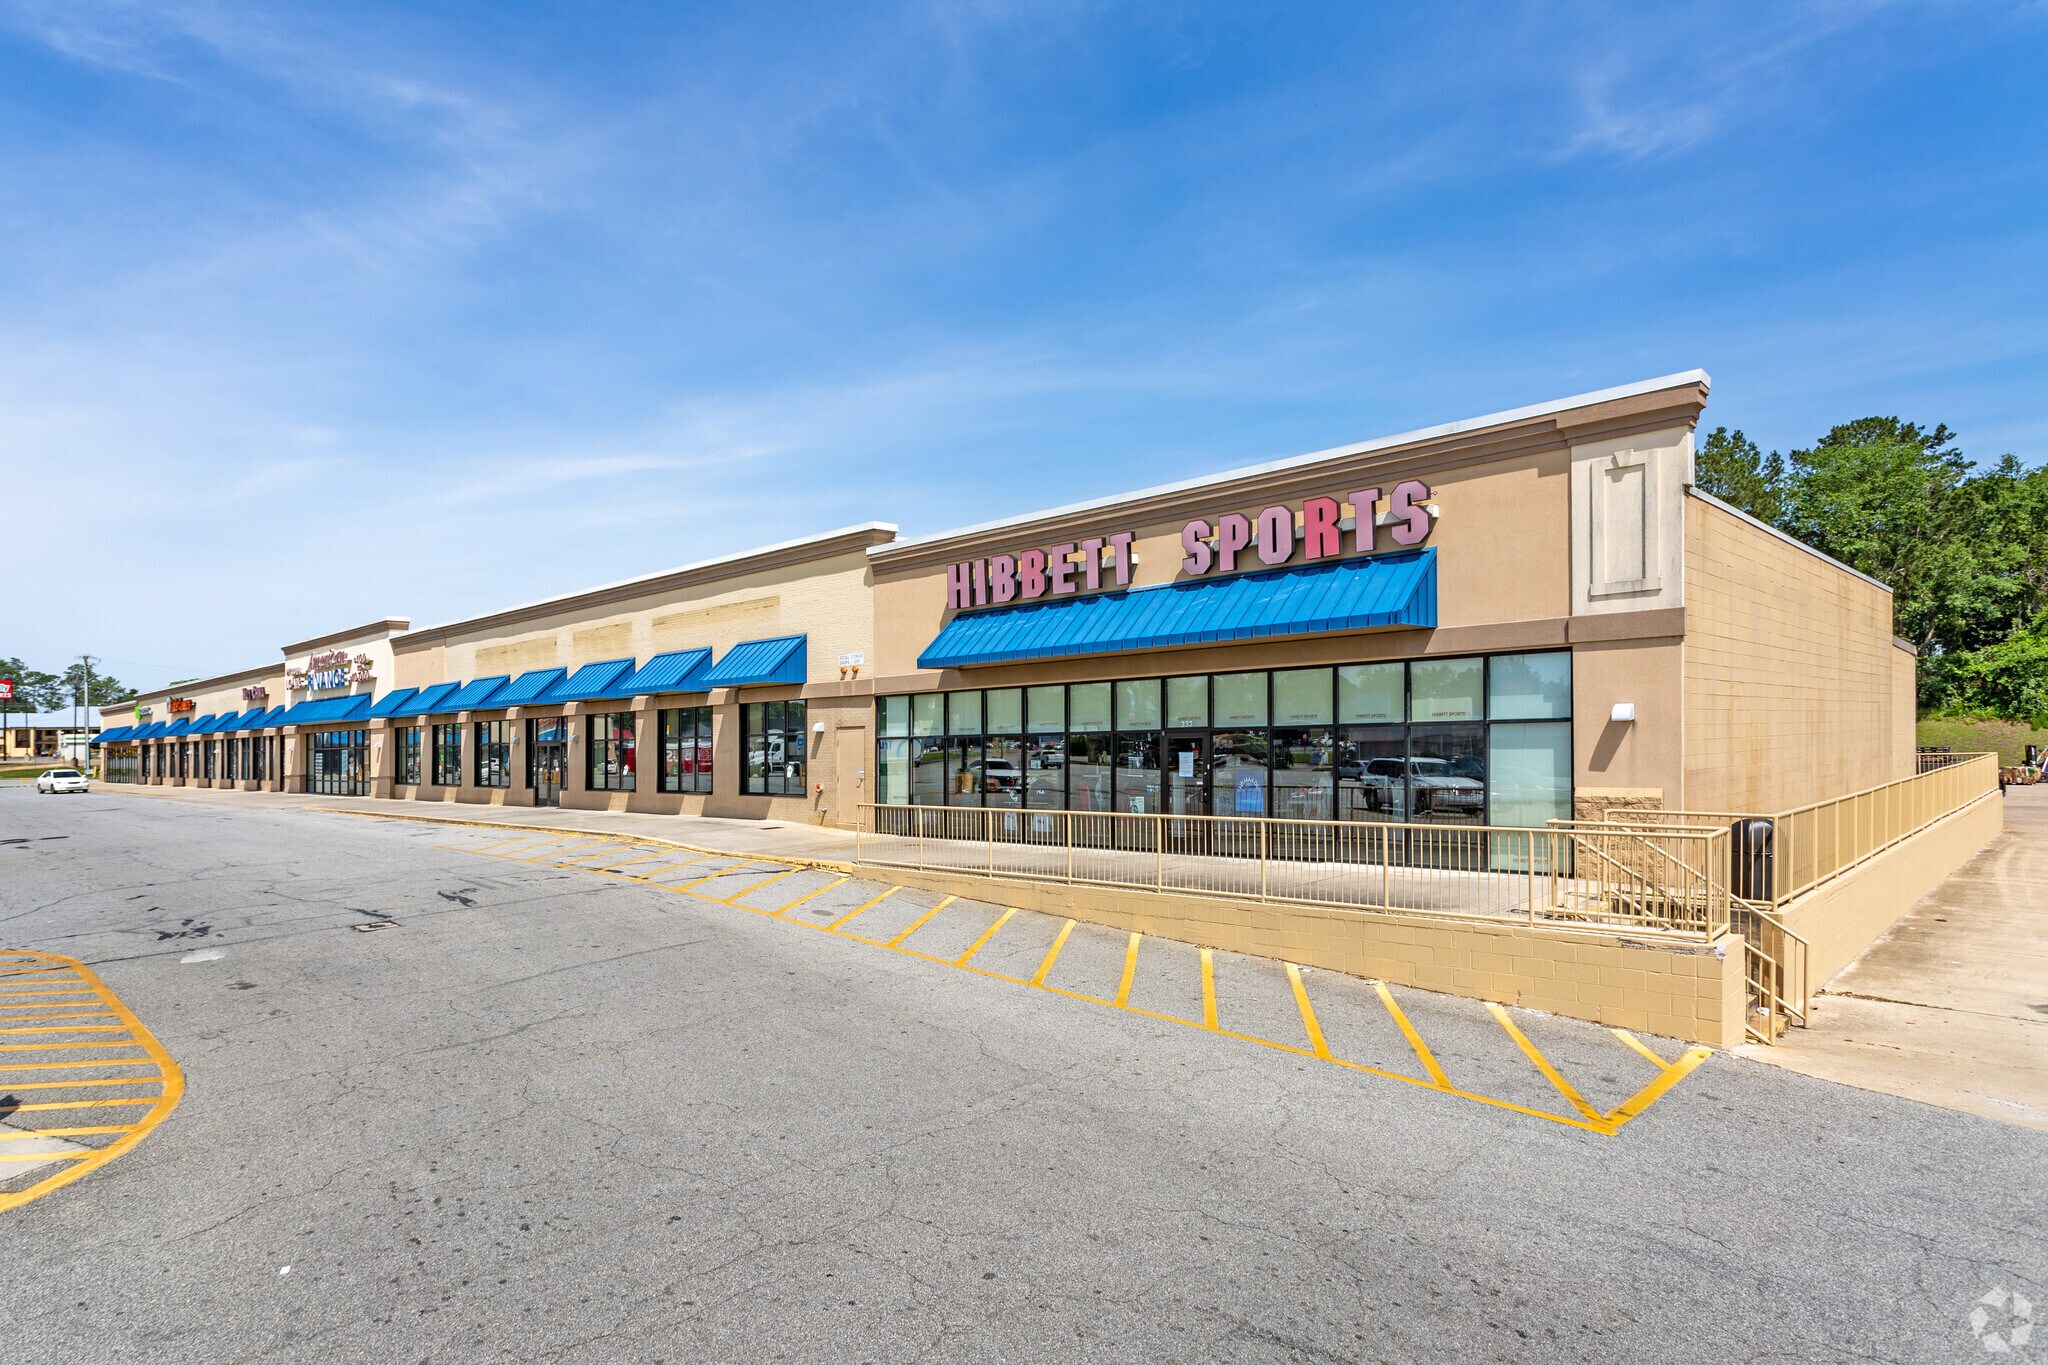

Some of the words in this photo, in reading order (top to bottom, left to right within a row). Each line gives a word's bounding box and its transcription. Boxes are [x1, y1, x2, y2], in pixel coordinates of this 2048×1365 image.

[947, 532, 1136, 609] HIBBETT
[1182, 479, 1431, 576] SPORTS
[307, 667, 346, 691] FINANCE
